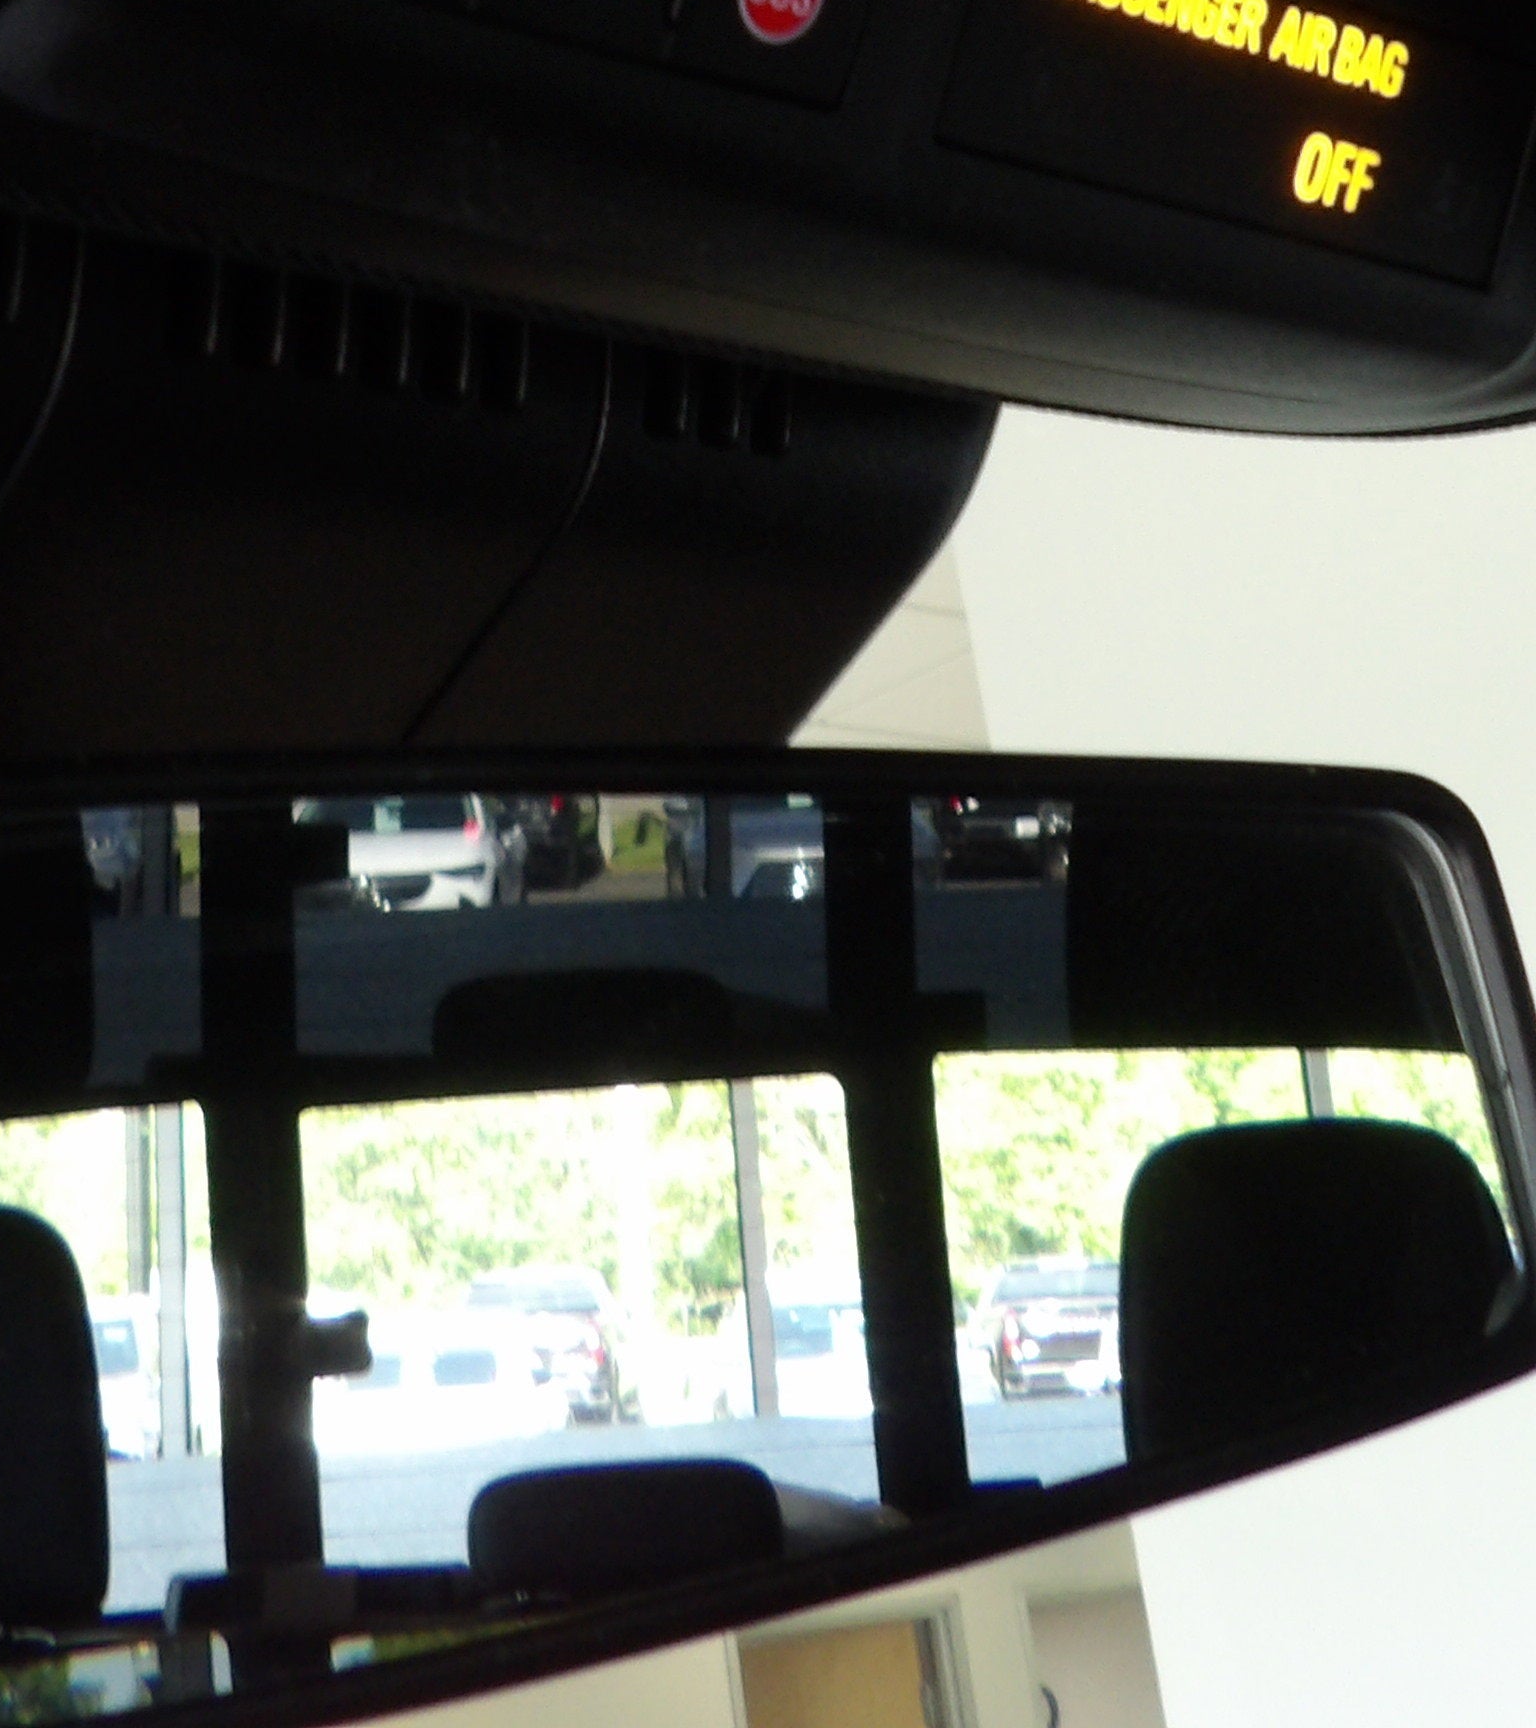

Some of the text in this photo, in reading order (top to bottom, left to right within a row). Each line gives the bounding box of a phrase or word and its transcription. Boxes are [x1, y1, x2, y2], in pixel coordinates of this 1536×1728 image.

[1268, 5, 1337, 78] AIR
[1331, 24, 1410, 99] BAG
[1293, 131, 1382, 214] OFF
